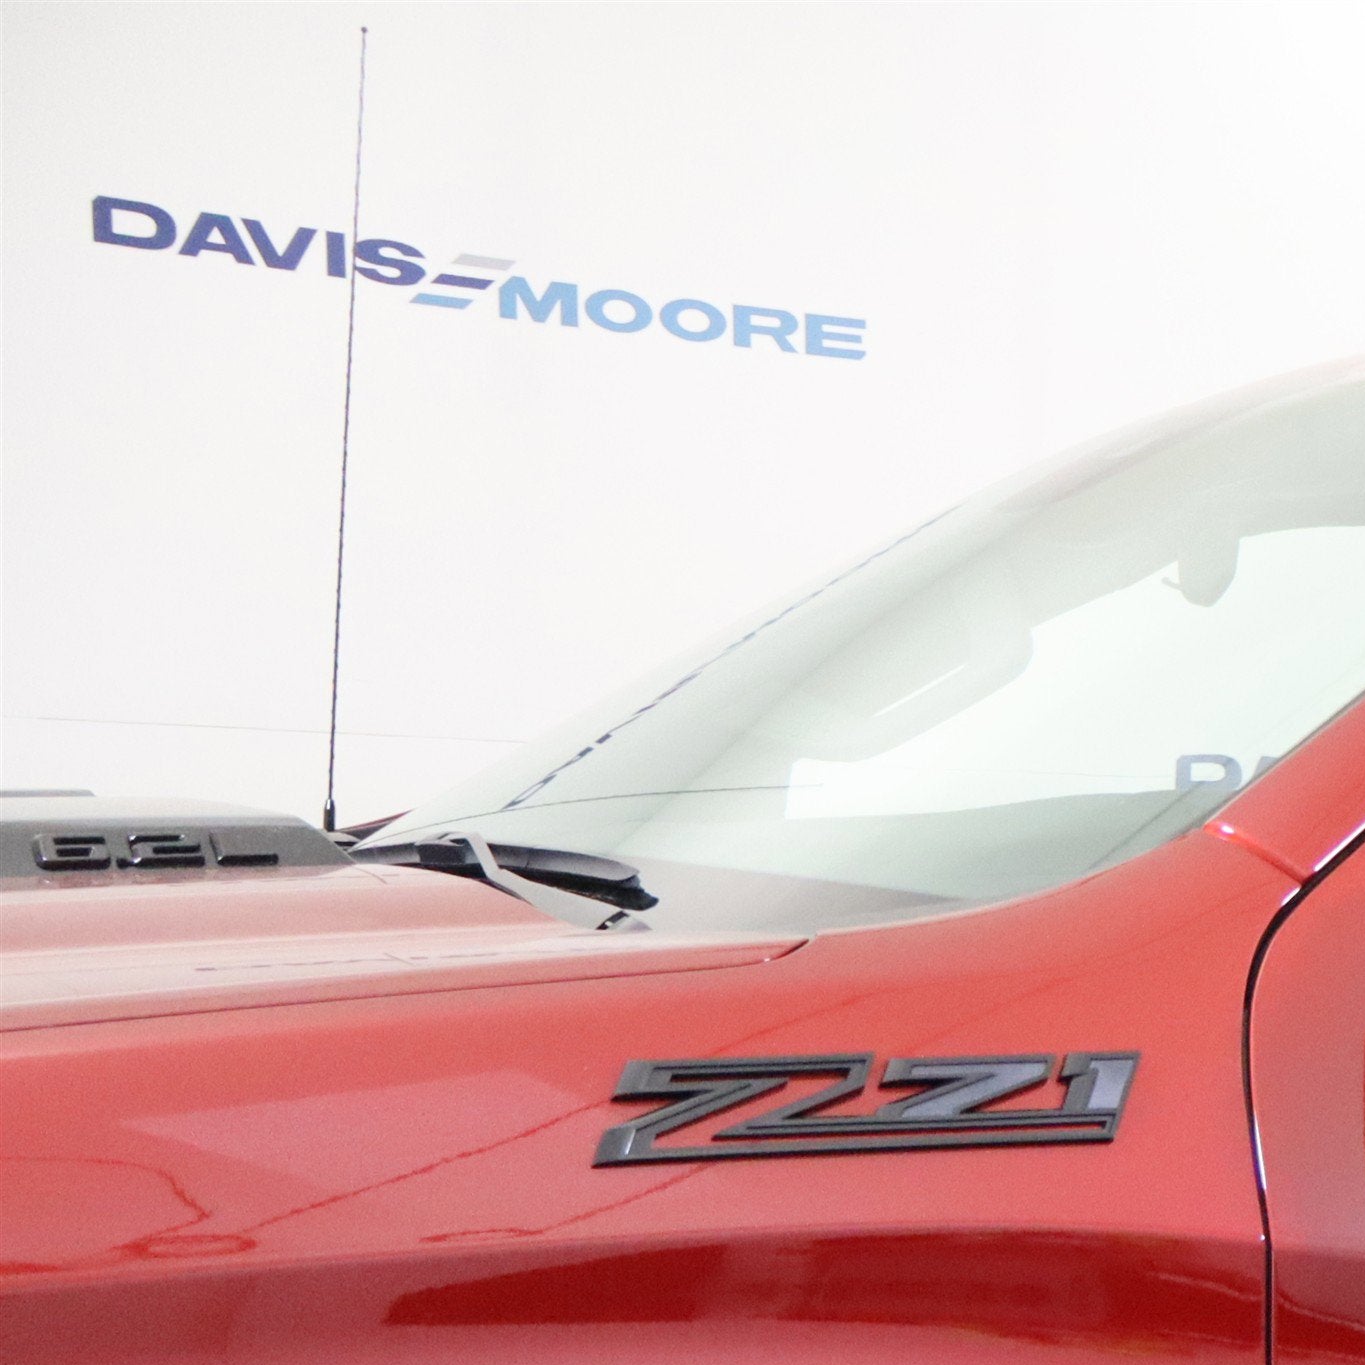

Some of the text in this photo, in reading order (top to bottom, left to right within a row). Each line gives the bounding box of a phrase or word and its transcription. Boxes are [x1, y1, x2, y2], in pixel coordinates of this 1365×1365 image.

[92, 195, 867, 361] DAVIS MOORE
[31, 830, 280, 870] 6.2L
